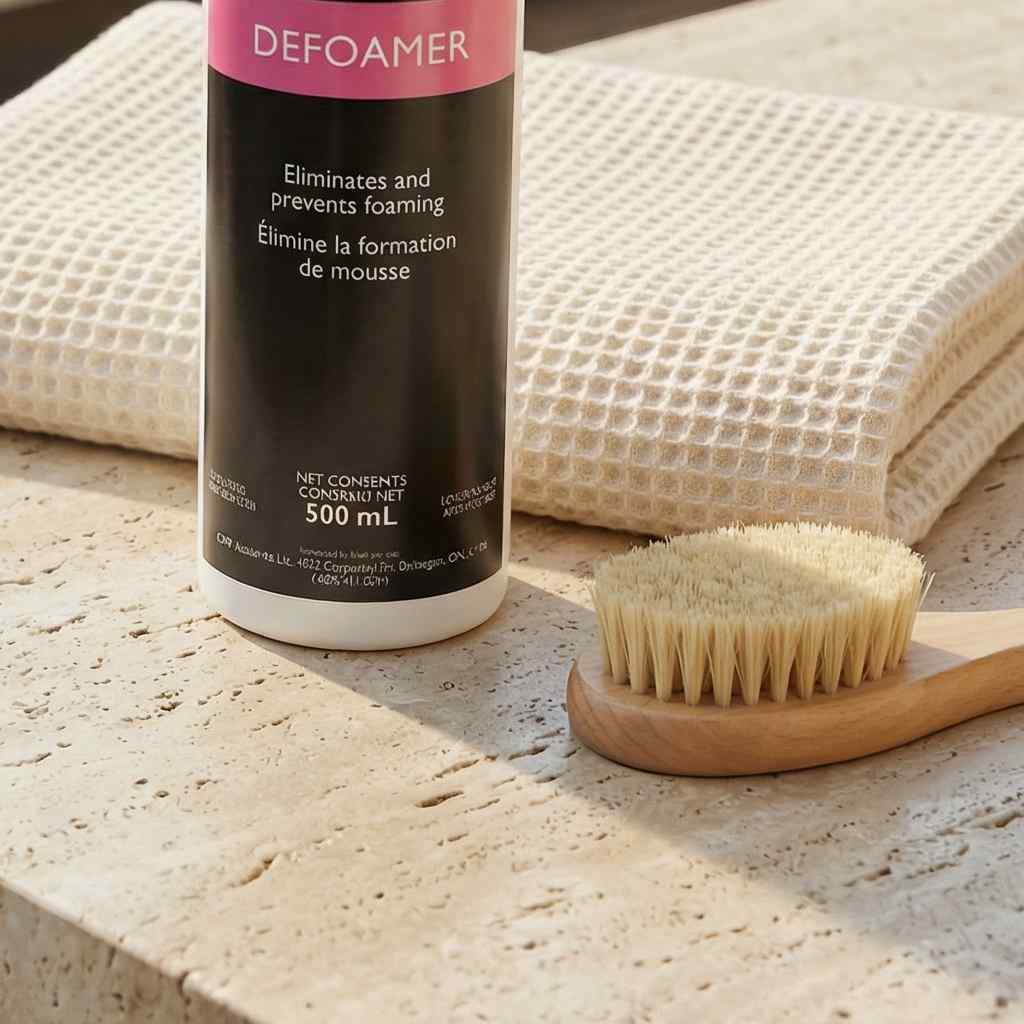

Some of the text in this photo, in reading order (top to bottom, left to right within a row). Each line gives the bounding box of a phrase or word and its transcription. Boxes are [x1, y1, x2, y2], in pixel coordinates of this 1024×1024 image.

[254, 23, 470, 68] DEFOAMER
[284, 163, 431, 190] Eliminates and
[271, 192, 445, 217] prevents foaming
[257, 218, 457, 256] Élimine la formation
[299, 257, 411, 281] de mousse
[296, 470, 324, 486] NET
[376, 488, 405, 502] NET
[305, 502, 398, 526] 500 mL
